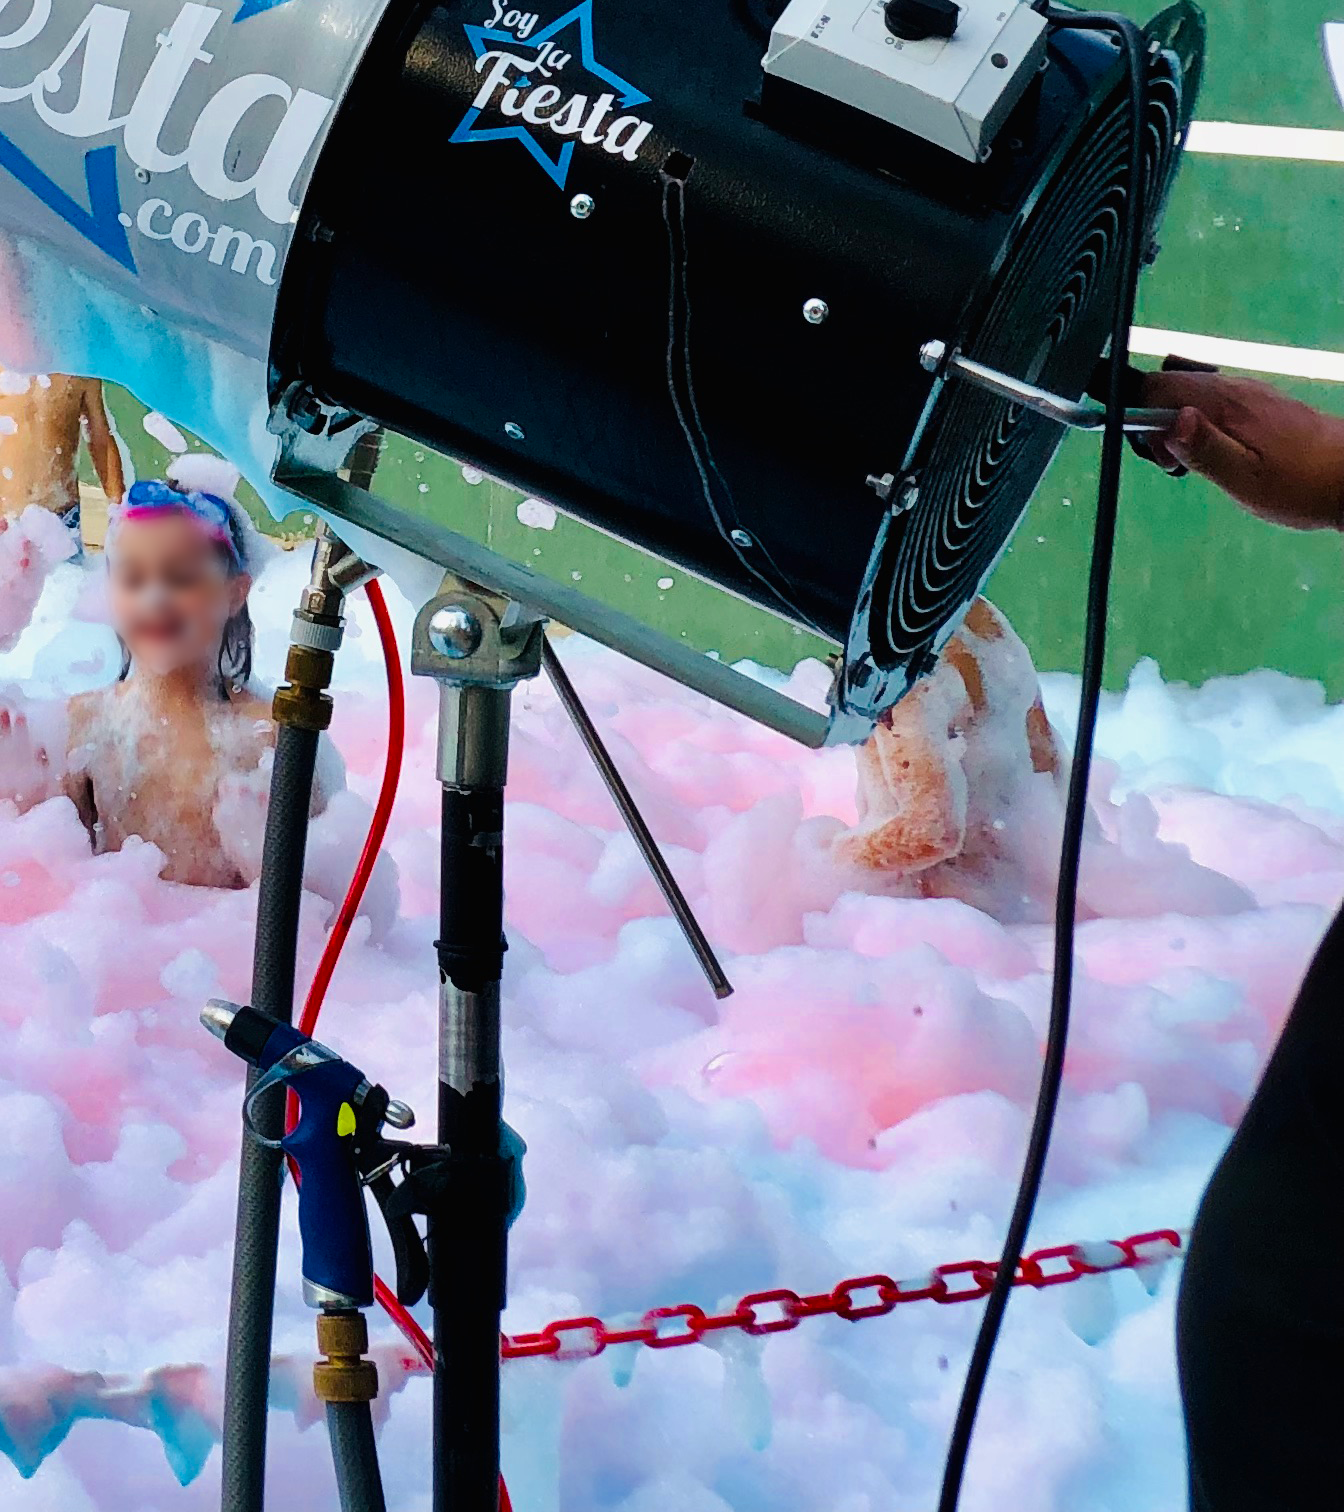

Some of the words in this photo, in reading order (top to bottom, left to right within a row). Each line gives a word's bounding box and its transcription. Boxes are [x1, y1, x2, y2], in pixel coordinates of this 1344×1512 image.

[531, 41, 572, 78] La
[471, 50, 654, 162] Fiesta
[117, 197, 281, 286] .com
